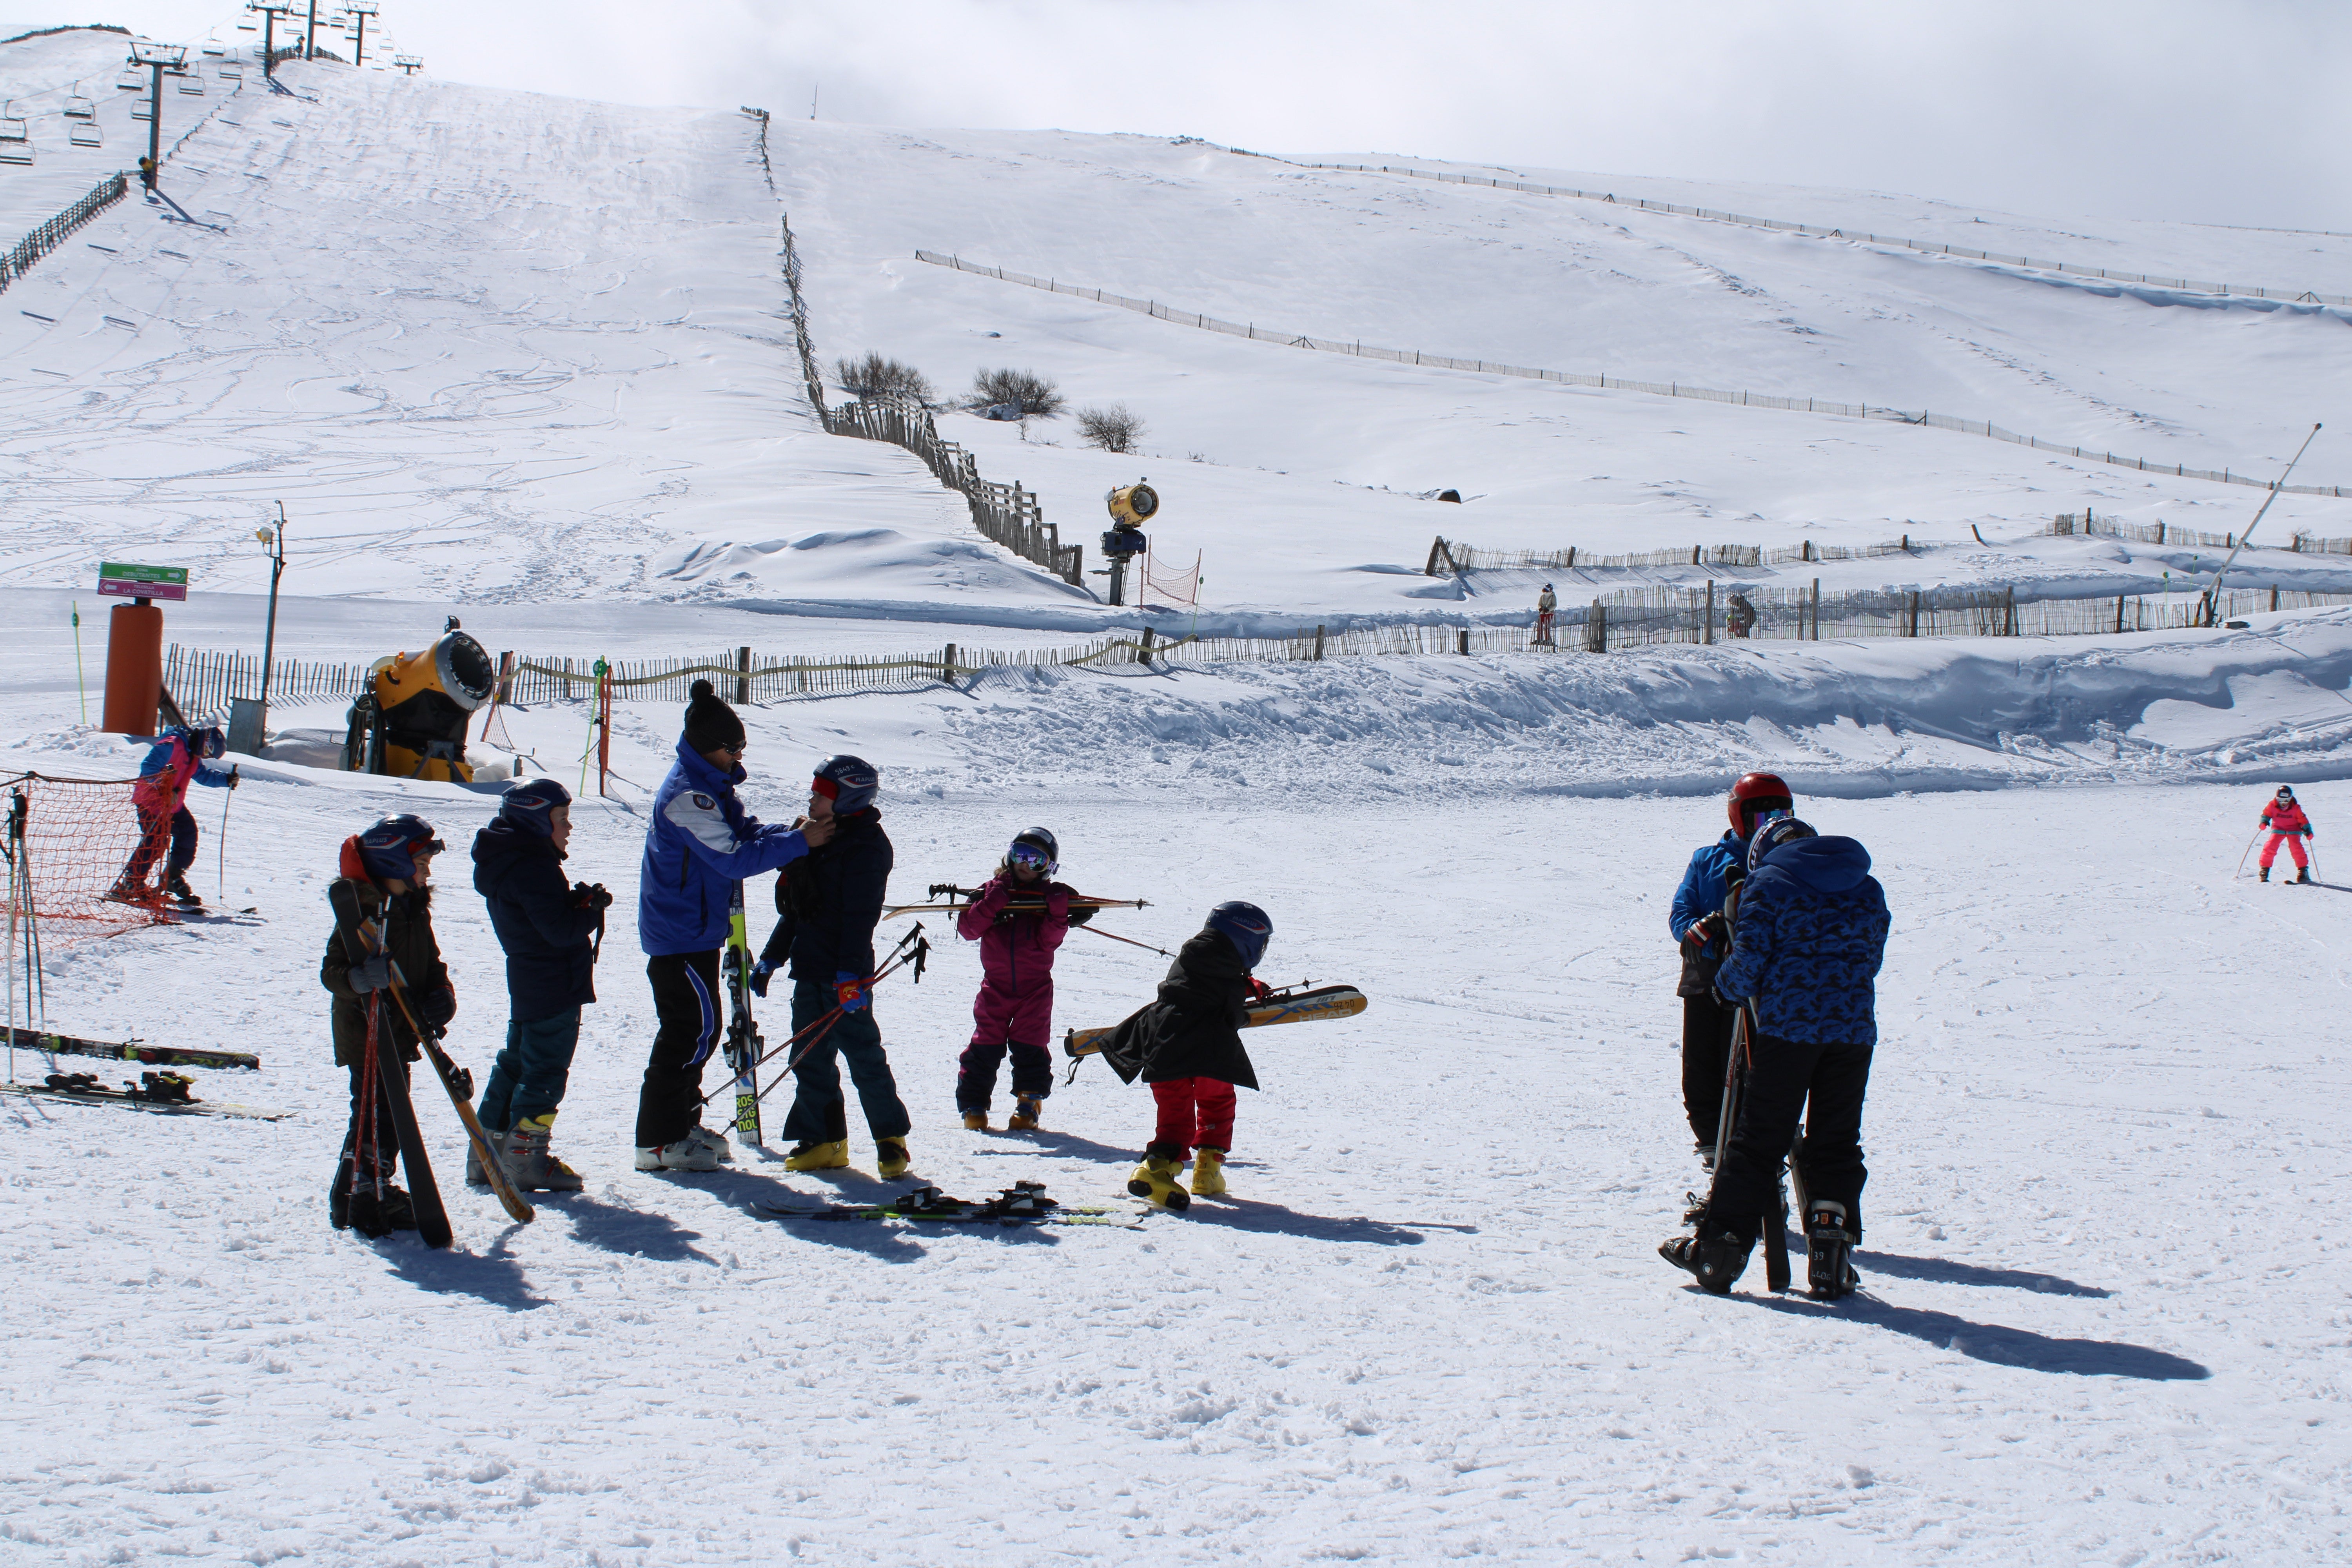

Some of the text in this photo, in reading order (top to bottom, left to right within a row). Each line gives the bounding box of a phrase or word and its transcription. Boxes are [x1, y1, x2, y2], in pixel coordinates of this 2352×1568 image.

[1299, 1009, 1353, 1022] HEAD
[737, 1094, 754, 1108] ROS
[1813, 1251, 1824, 1261] 39
